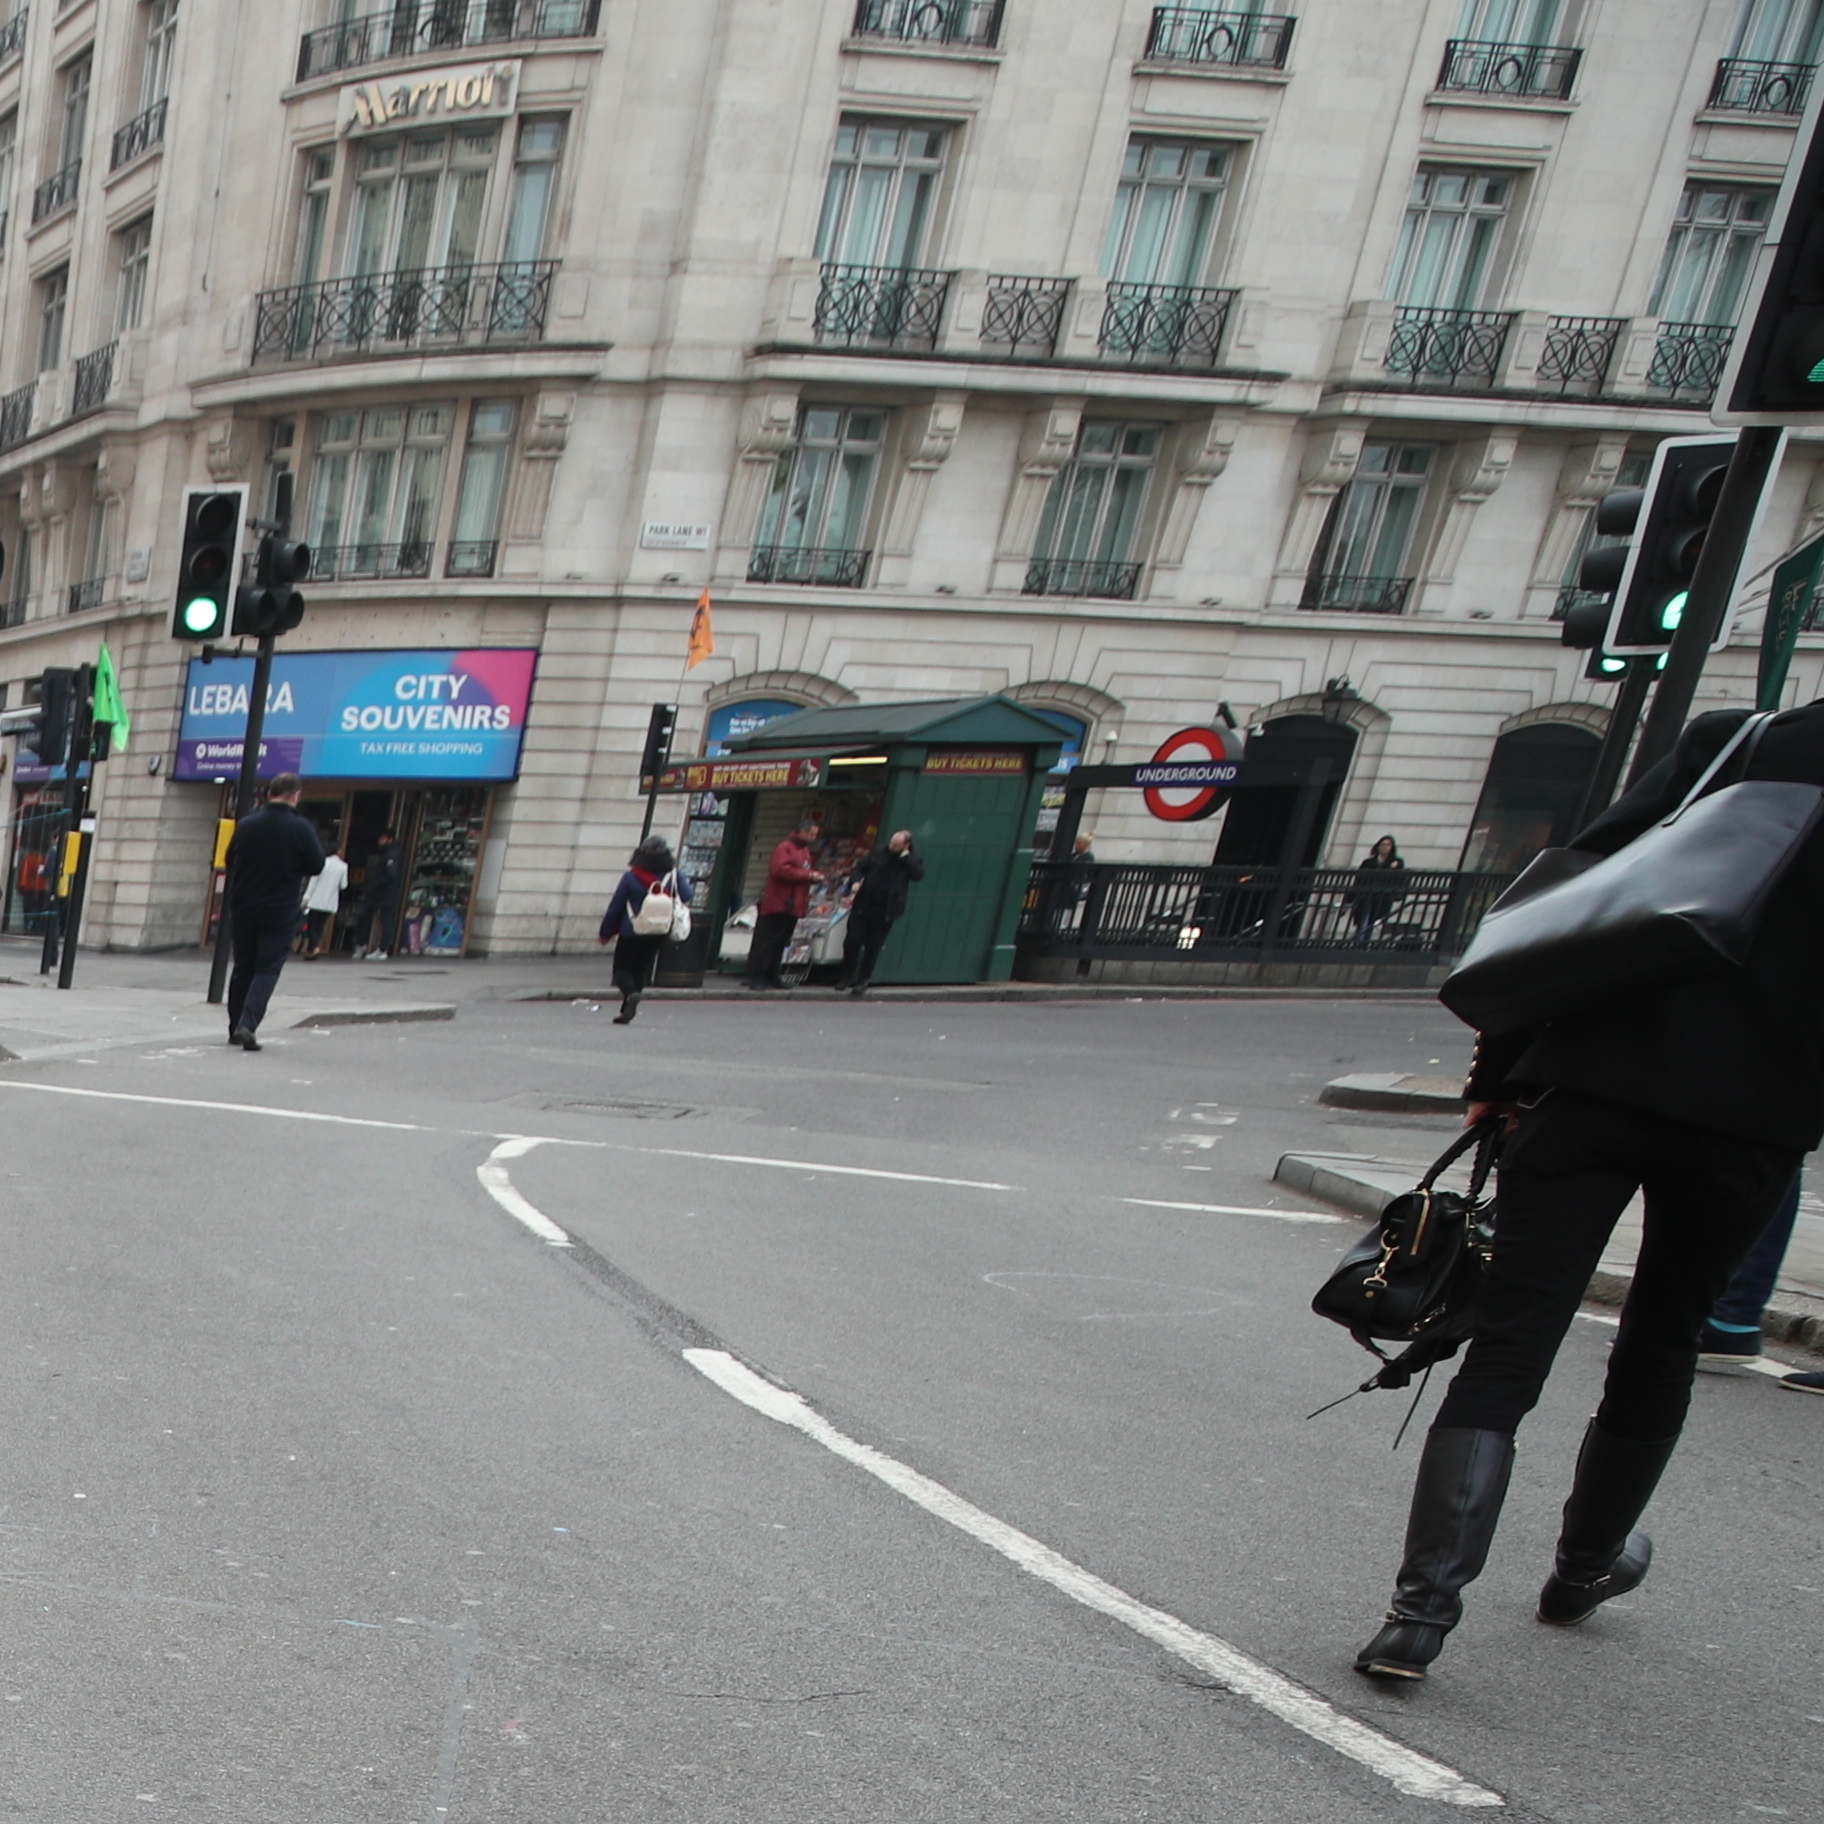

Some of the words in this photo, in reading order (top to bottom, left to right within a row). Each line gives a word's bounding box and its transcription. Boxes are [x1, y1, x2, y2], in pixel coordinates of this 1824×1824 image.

[395, 674, 468, 702] CITY
[189, 680, 295, 716] LEBAA
[341, 705, 511, 731] SOUVENIRS
[208, 743, 268, 758] WorldRit
[360, 743, 385, 755] TAX
[386, 743, 417, 755] FREE
[418, 742, 483, 755] SHOPPING
[927, 757, 948, 769] BUY
[950, 757, 992, 769] TICKETS
[995, 757, 1023, 769] HERE
[712, 770, 728, 784] BUY
[730, 769, 763, 783] TICKETS
[765, 768, 789, 782] HERE
[1136, 765, 1237, 782] UNDERGROUND
